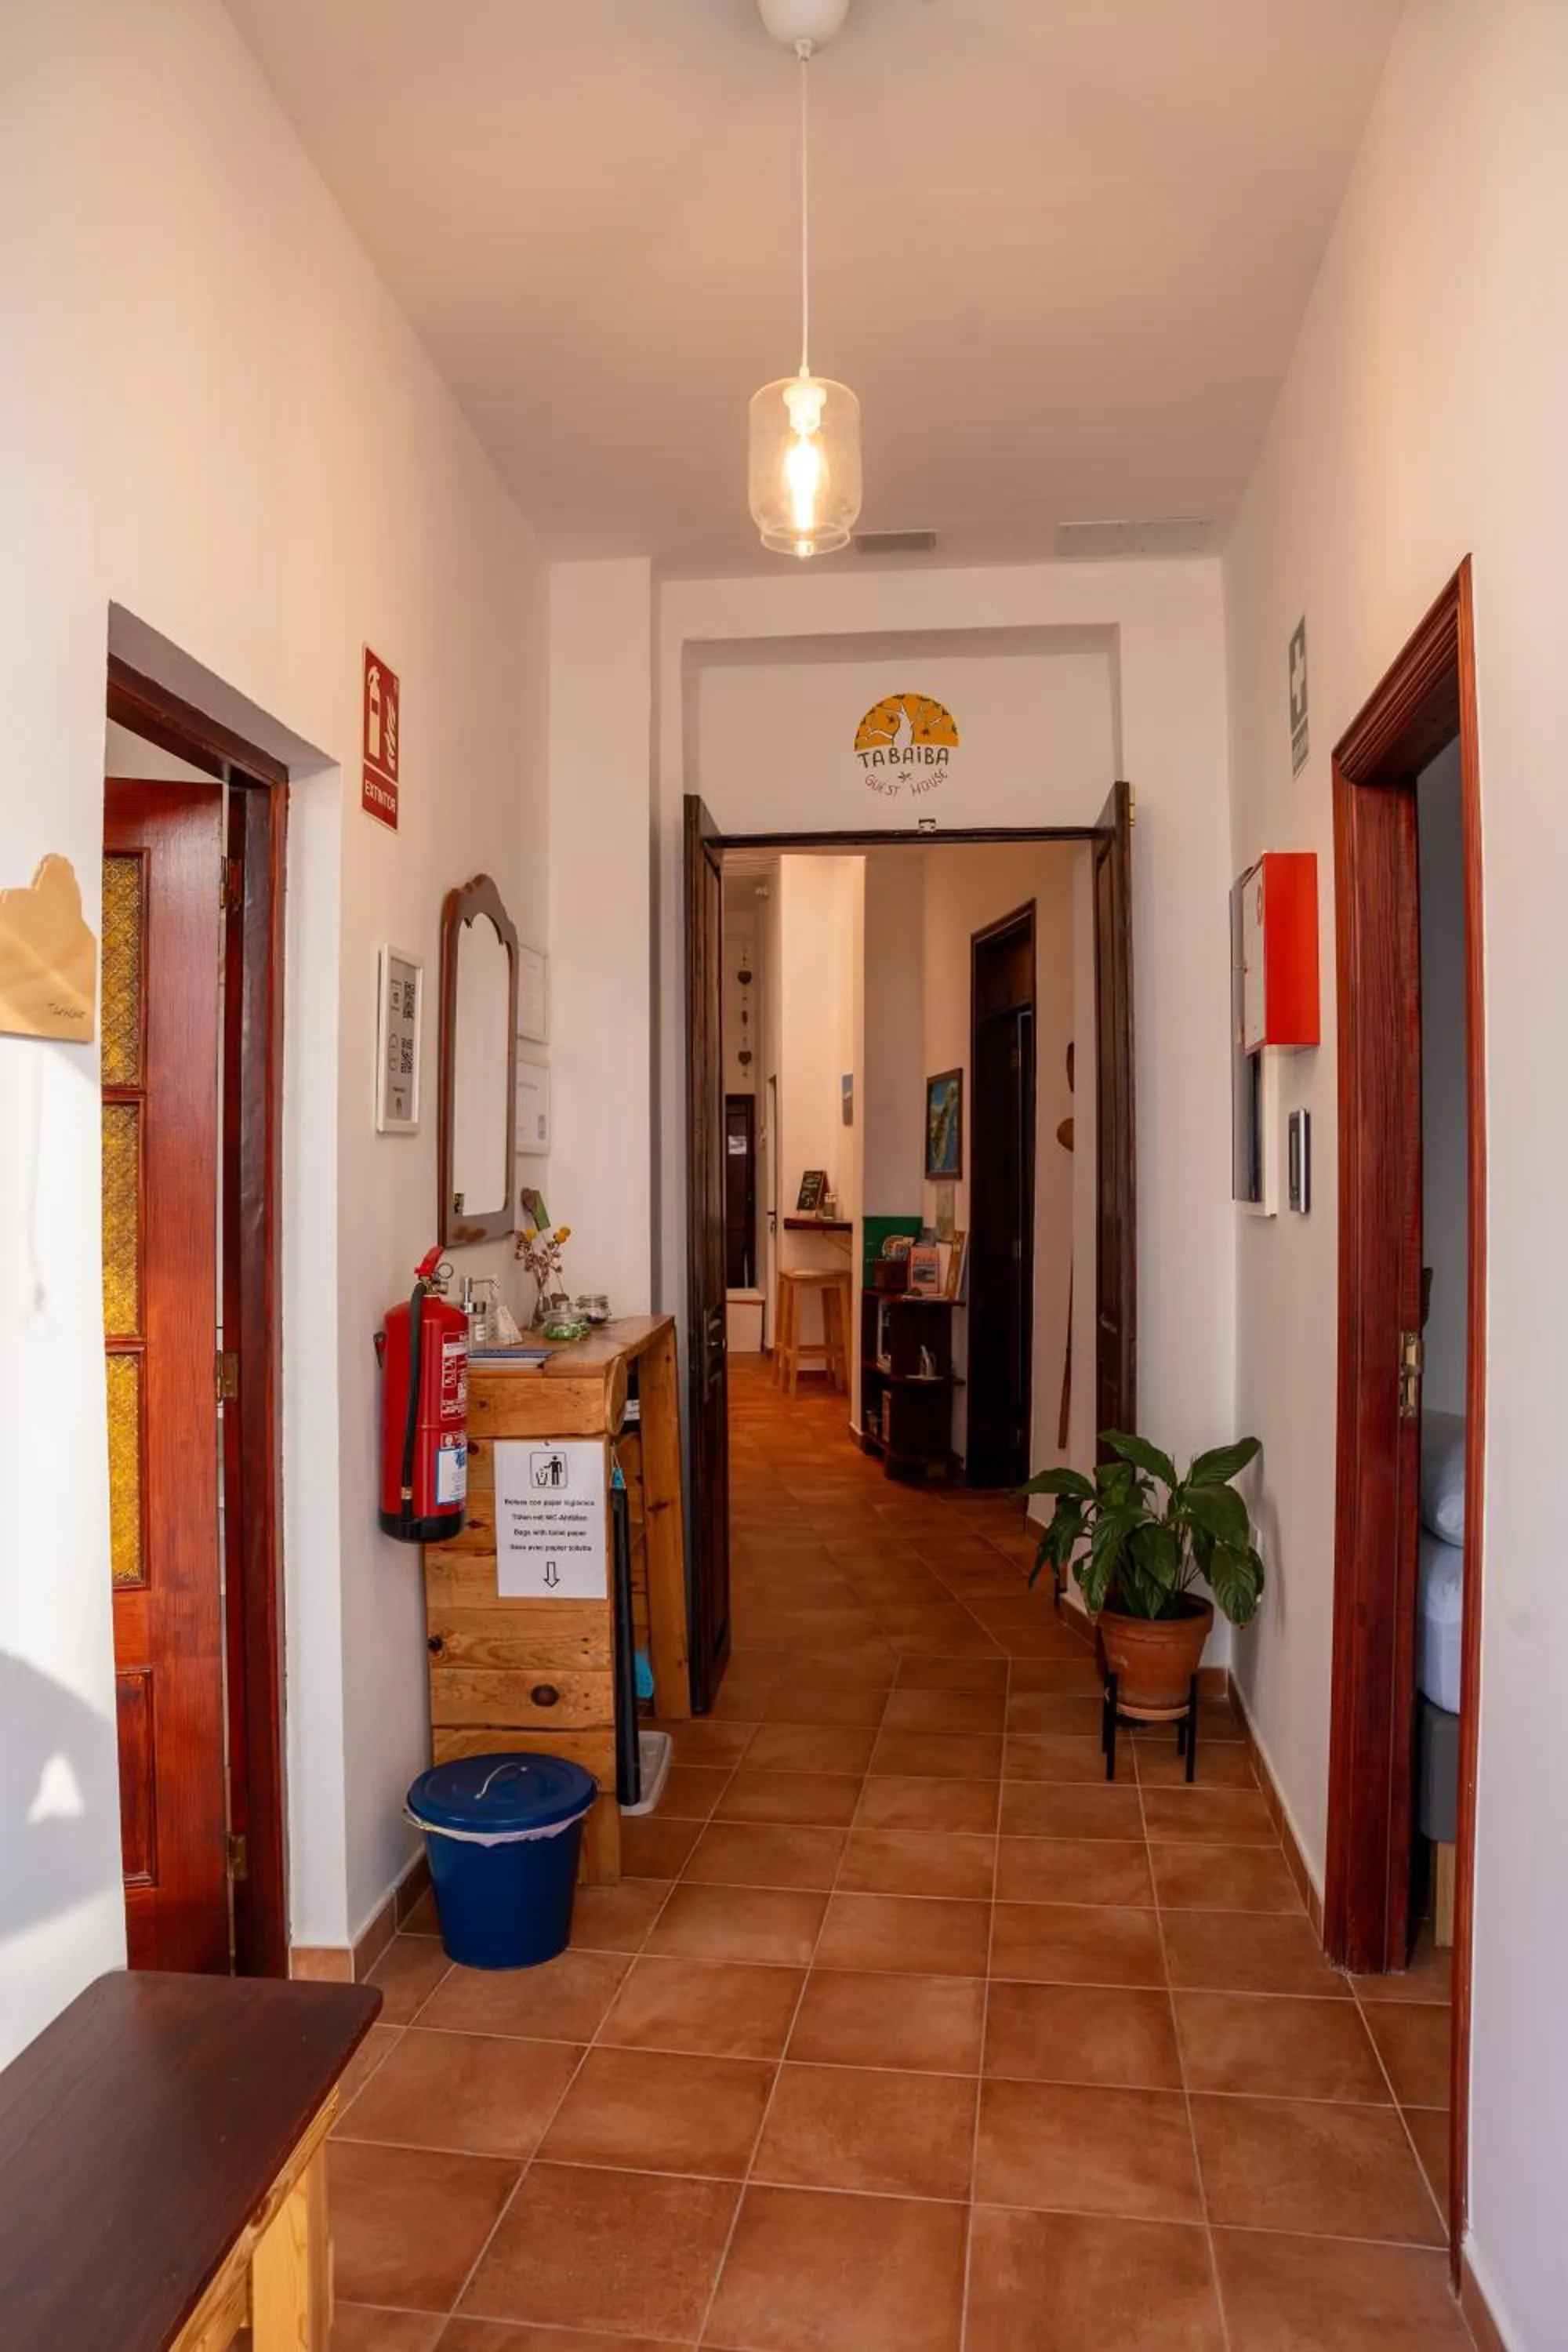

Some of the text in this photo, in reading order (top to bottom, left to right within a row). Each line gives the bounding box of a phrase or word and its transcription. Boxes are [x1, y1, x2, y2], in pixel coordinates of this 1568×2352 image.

[365, 779, 396, 814] EXTINTOR
[865, 768, 948, 797] GUEST HOUSE
[514, 1528, 531, 1537] Bags
